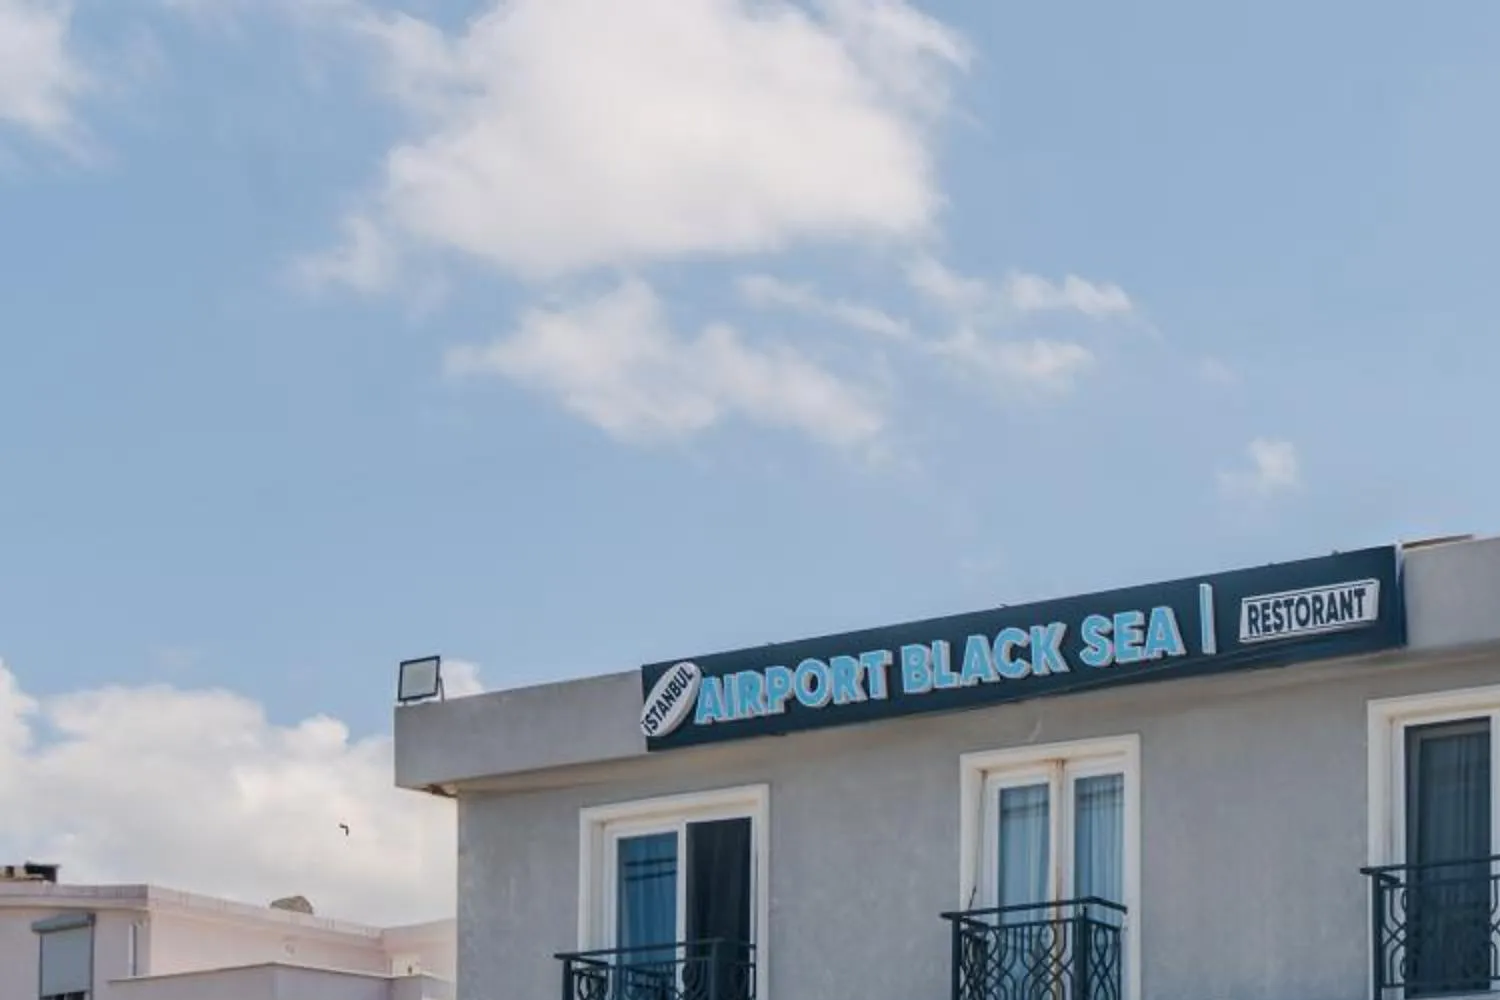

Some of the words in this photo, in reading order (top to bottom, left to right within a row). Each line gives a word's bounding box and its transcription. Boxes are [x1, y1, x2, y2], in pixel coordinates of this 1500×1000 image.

[1248, 587, 1367, 635] RESTORANT
[694, 648, 893, 725] AIRPORT
[902, 621, 1070, 695] BLACK
[1079, 606, 1187, 668] SEA
